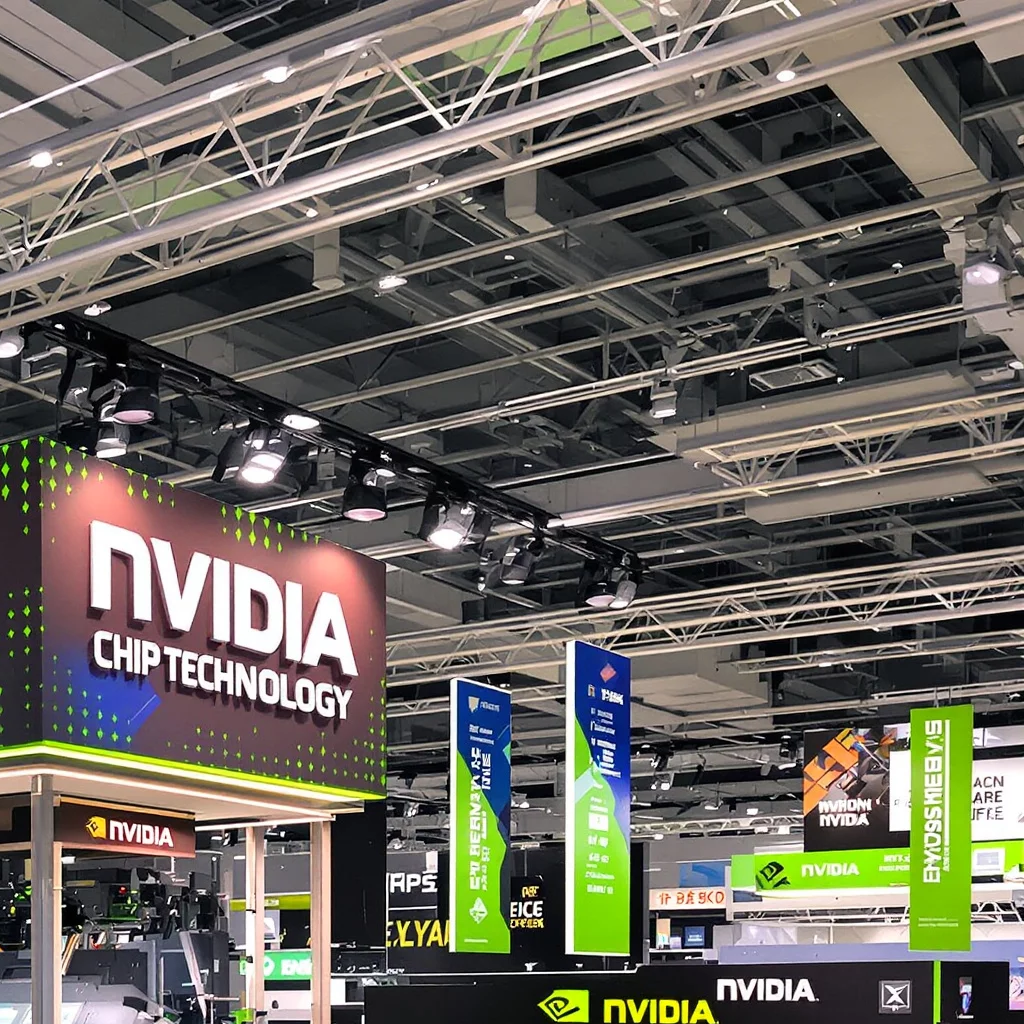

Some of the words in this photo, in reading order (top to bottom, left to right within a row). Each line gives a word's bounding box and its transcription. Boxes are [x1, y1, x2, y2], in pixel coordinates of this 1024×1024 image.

[90, 519, 359, 677] NVIDIA
[93, 629, 161, 676] CHIP
[163, 646, 353, 720] TECHNOLOGY
[109, 820, 174, 847] NVIDIA
[801, 862, 860, 878] NVIDIA
